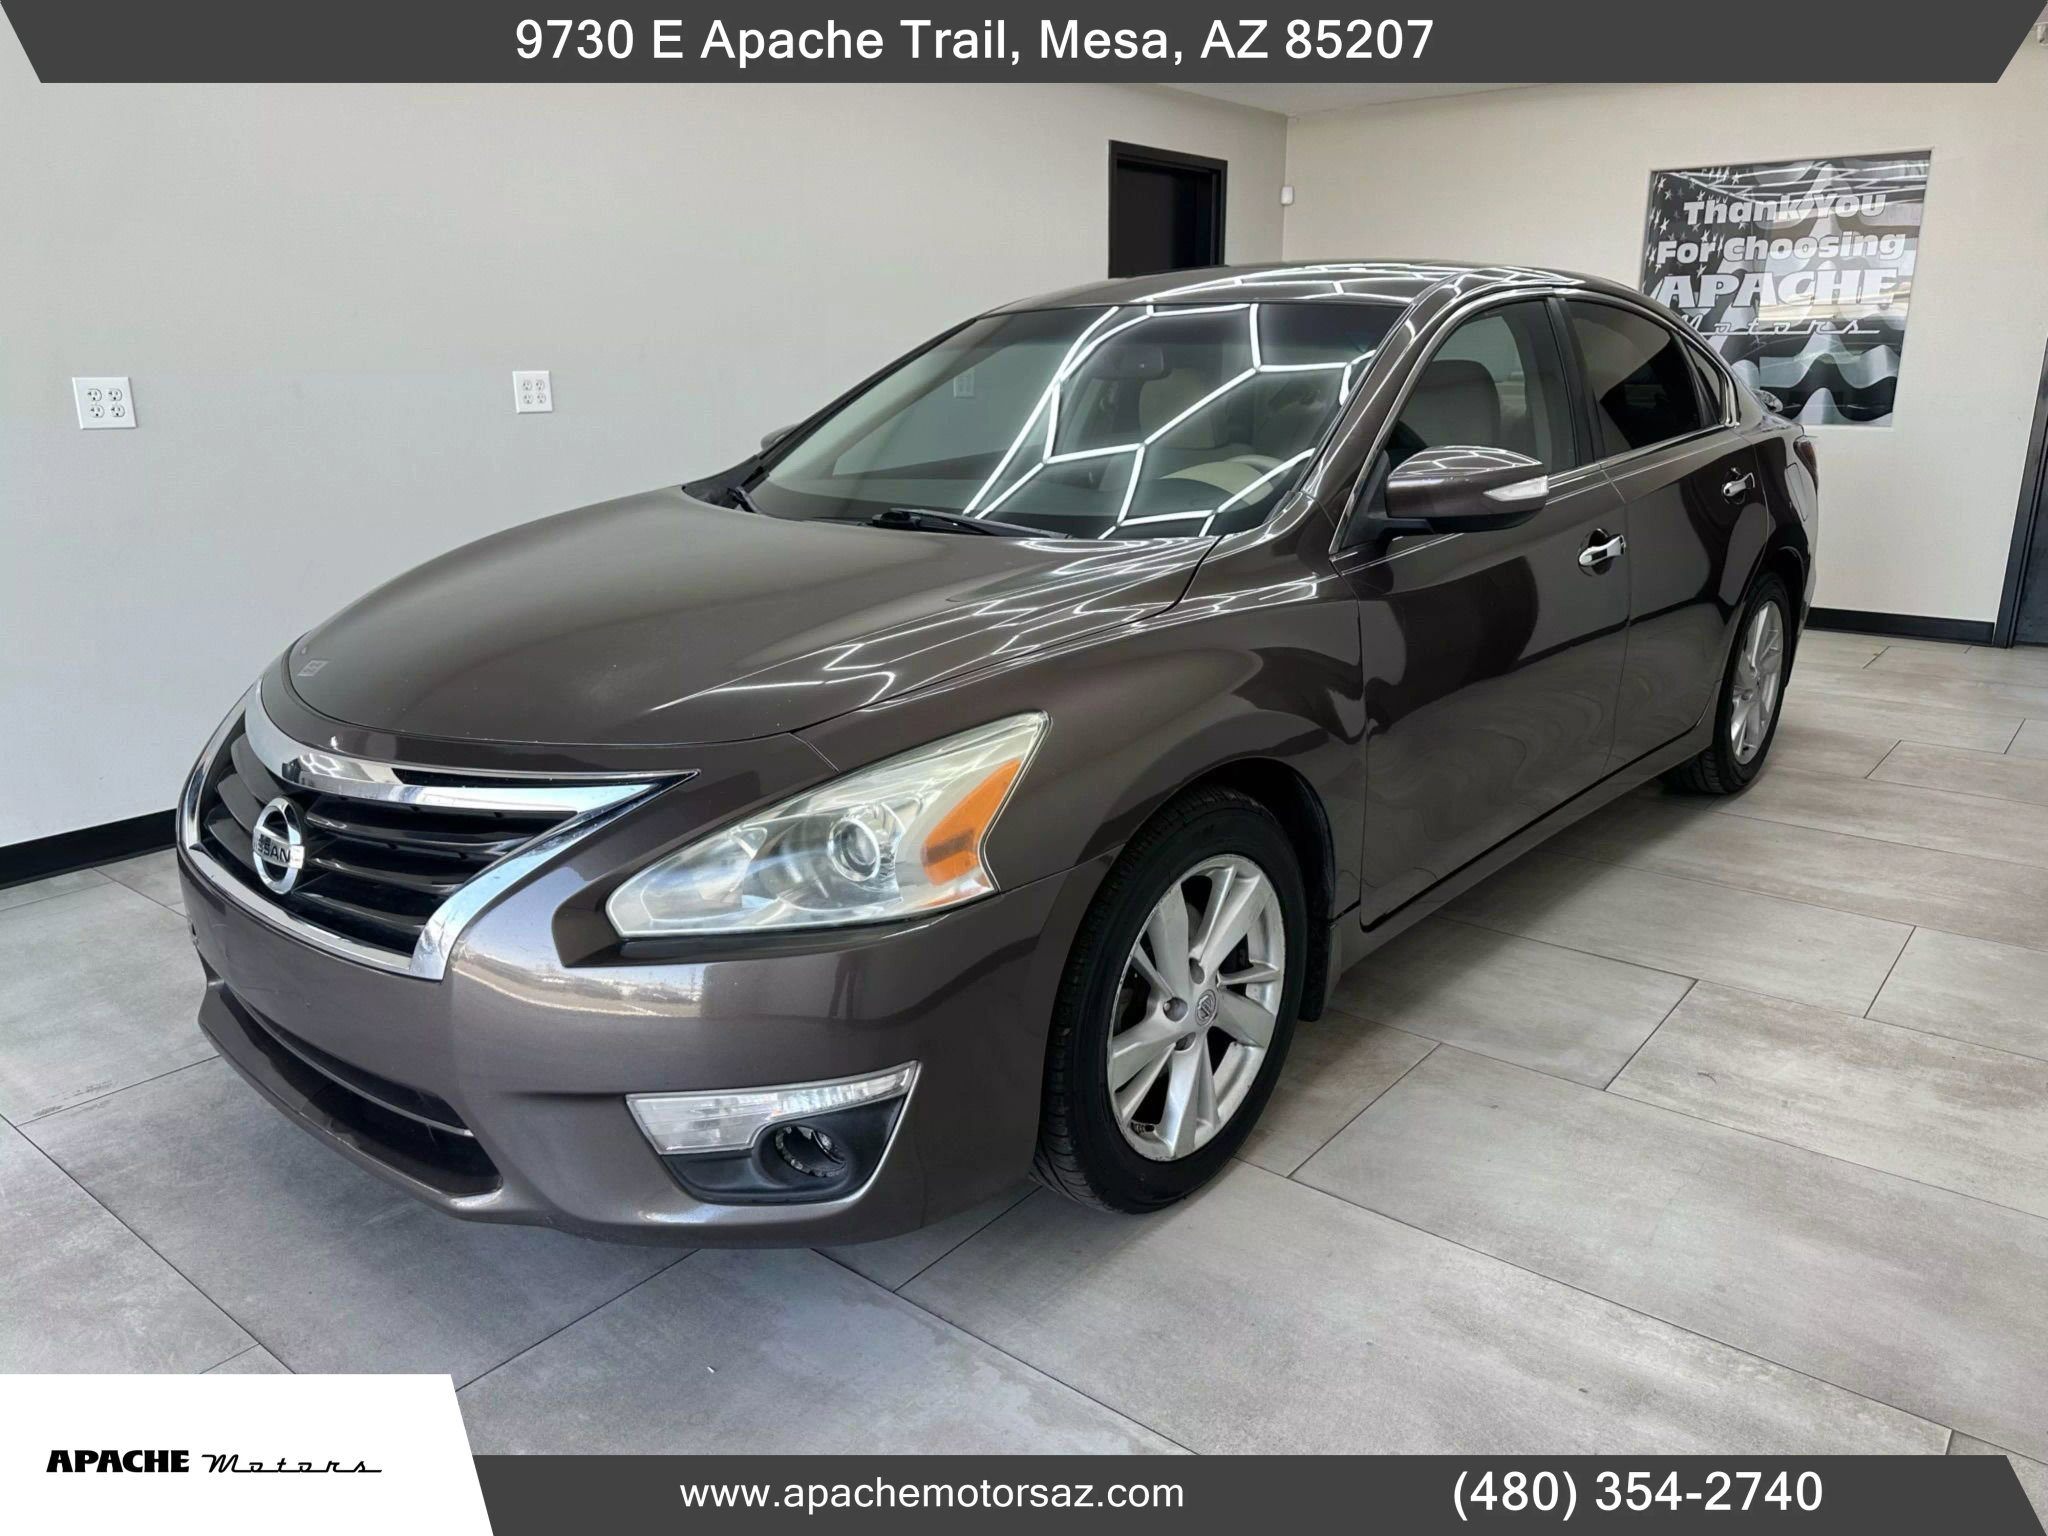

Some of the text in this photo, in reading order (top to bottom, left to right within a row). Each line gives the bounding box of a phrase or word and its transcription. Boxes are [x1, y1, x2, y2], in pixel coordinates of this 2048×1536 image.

[1683, 194, 1809, 226] Thank
[1657, 231, 1906, 265] For Choosing
[1655, 268, 1899, 308] APACHE
